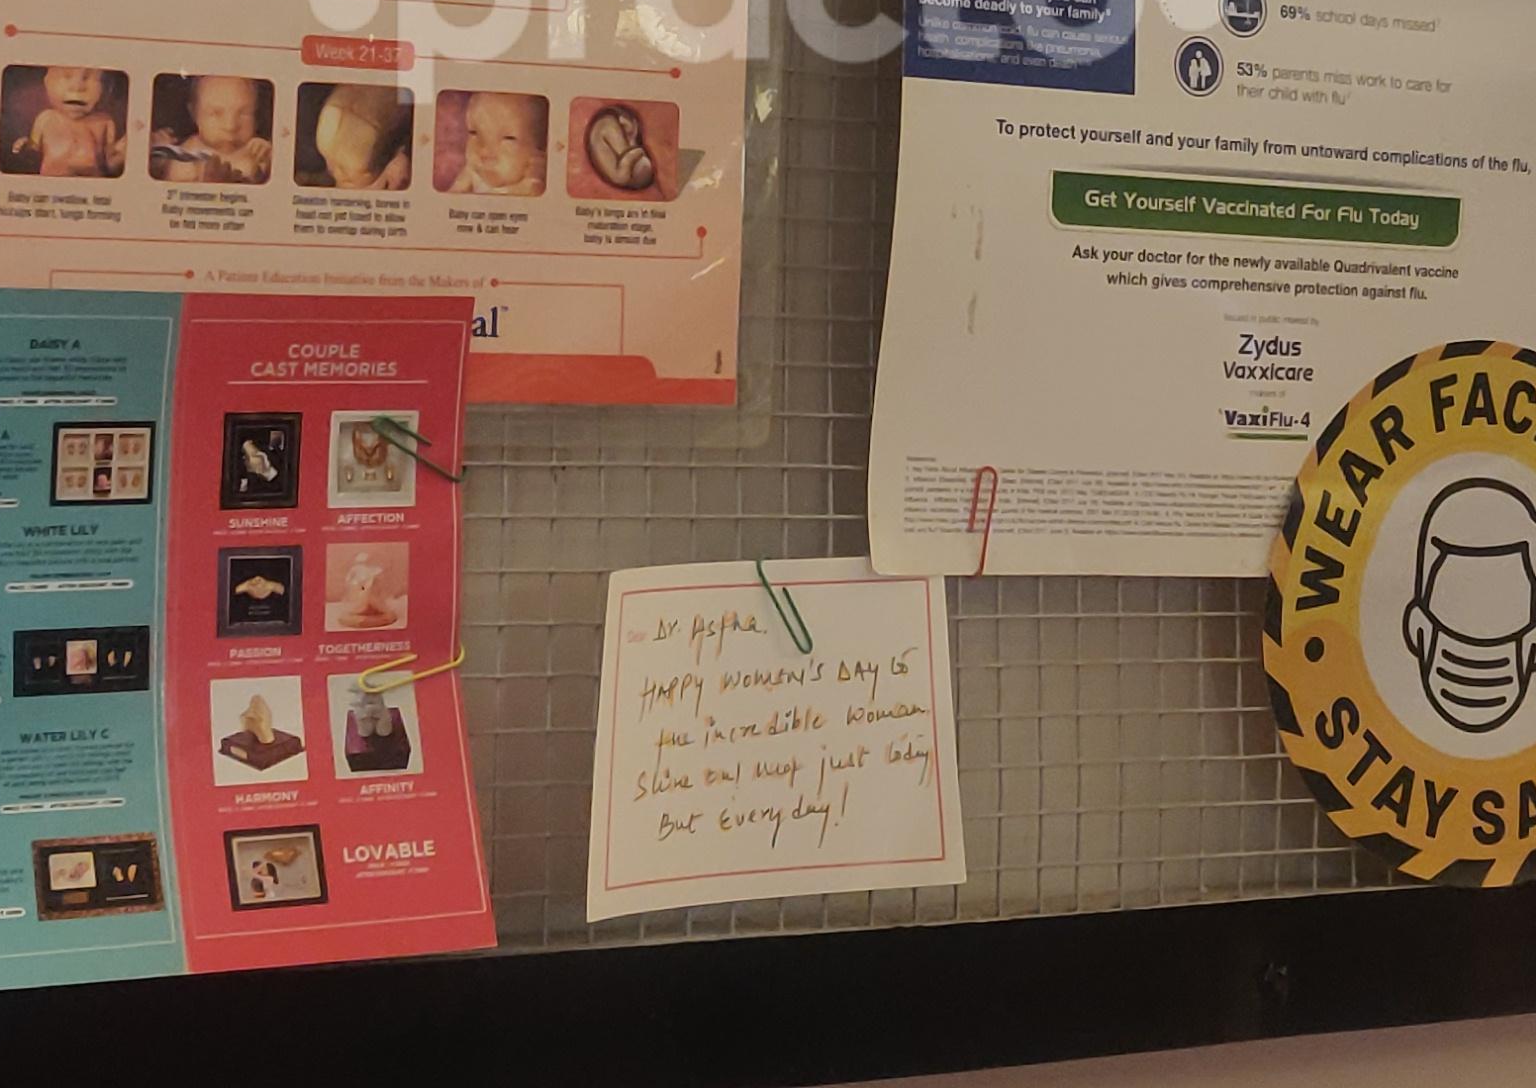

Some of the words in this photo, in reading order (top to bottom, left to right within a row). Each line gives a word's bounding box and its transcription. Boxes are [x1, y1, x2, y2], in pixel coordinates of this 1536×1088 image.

[1280, 4, 1311, 21] 69%
[315, 43, 355, 61] Week
[359, 44, 402, 62] 21-37
[1237, 61, 1267, 79] 53%
[997, 119, 1013, 136] To
[1019, 123, 1076, 143] protect
[1081, 124, 1142, 146] yourself
[1146, 130, 1173, 147] and
[1177, 134, 1211, 153] your
[1215, 136, 1259, 156] family
[1263, 137, 1296, 154] from
[1301, 141, 1368, 161] untoward
[1372, 149, 1468, 172] complications
[1472, 154, 1485, 171] of
[1488, 156, 1508, 172] the
[1511, 156, 1531, 176] flu,
[1085, 189, 1118, 210] Get
[1124, 191, 1196, 215] Yourself
[1202, 197, 1296, 220] Vaccinated
[1300, 204, 1331, 222] For
[1338, 204, 1363, 224] Flu
[1369, 208, 1420, 230] Today
[288, 344, 360, 359] COUPLE
[1239, 334, 1302, 360] Zydus
[251, 362, 299, 377] CAST
[304, 362, 397, 377] MEMORIES
[1294, 405, 1413, 613] WEAR
[229, 517, 288, 529] SUNSHINE
[338, 513, 404, 524] AFFECTION
[230, 647, 281, 658] PASSION
[319, 642, 410, 653] TOGETHERNESS
[1314, 695, 1459, 842] STAY
[360, 781, 414, 796] AFFINITY
[236, 791, 298, 804] HARMONY
[343, 841, 435, 863] LOVABLE
